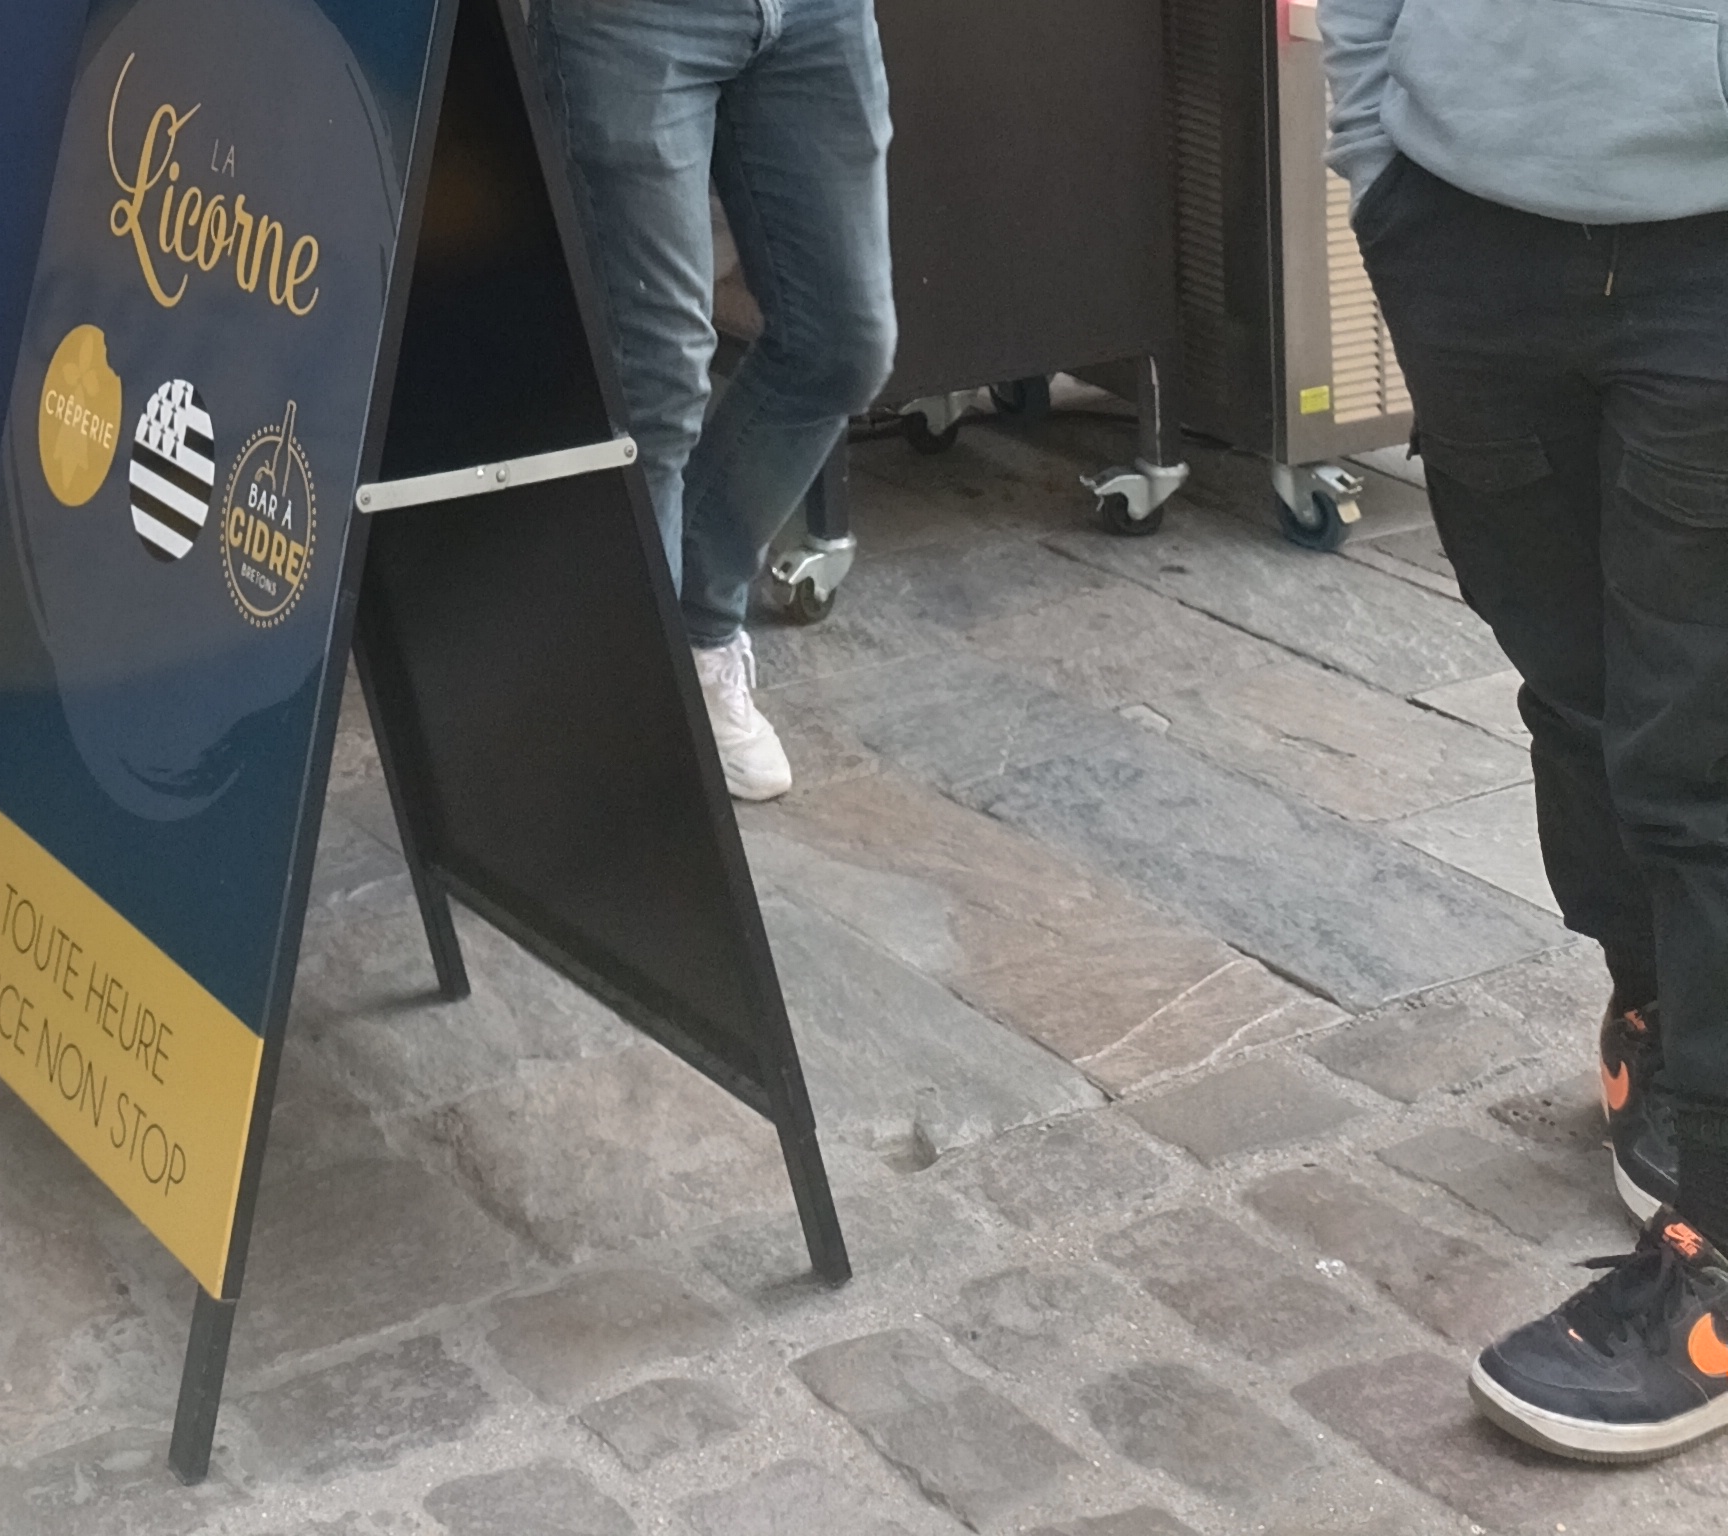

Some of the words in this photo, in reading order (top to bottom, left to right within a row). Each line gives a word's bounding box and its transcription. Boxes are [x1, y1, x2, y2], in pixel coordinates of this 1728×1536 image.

[108, 52, 320, 316] Licorne
[210, 136, 237, 179] LA
[44, 389, 114, 450] CRÊPERIE
[248, 482, 278, 521] BAR
[228, 506, 308, 587] CIDRE
[240, 562, 277, 597] BRETONS
[1, 882, 84, 1001] TOUTE
[85, 960, 173, 1086] HEURE
[35, 1018, 108, 1129] NON
[110, 1092, 187, 1197] STOP
